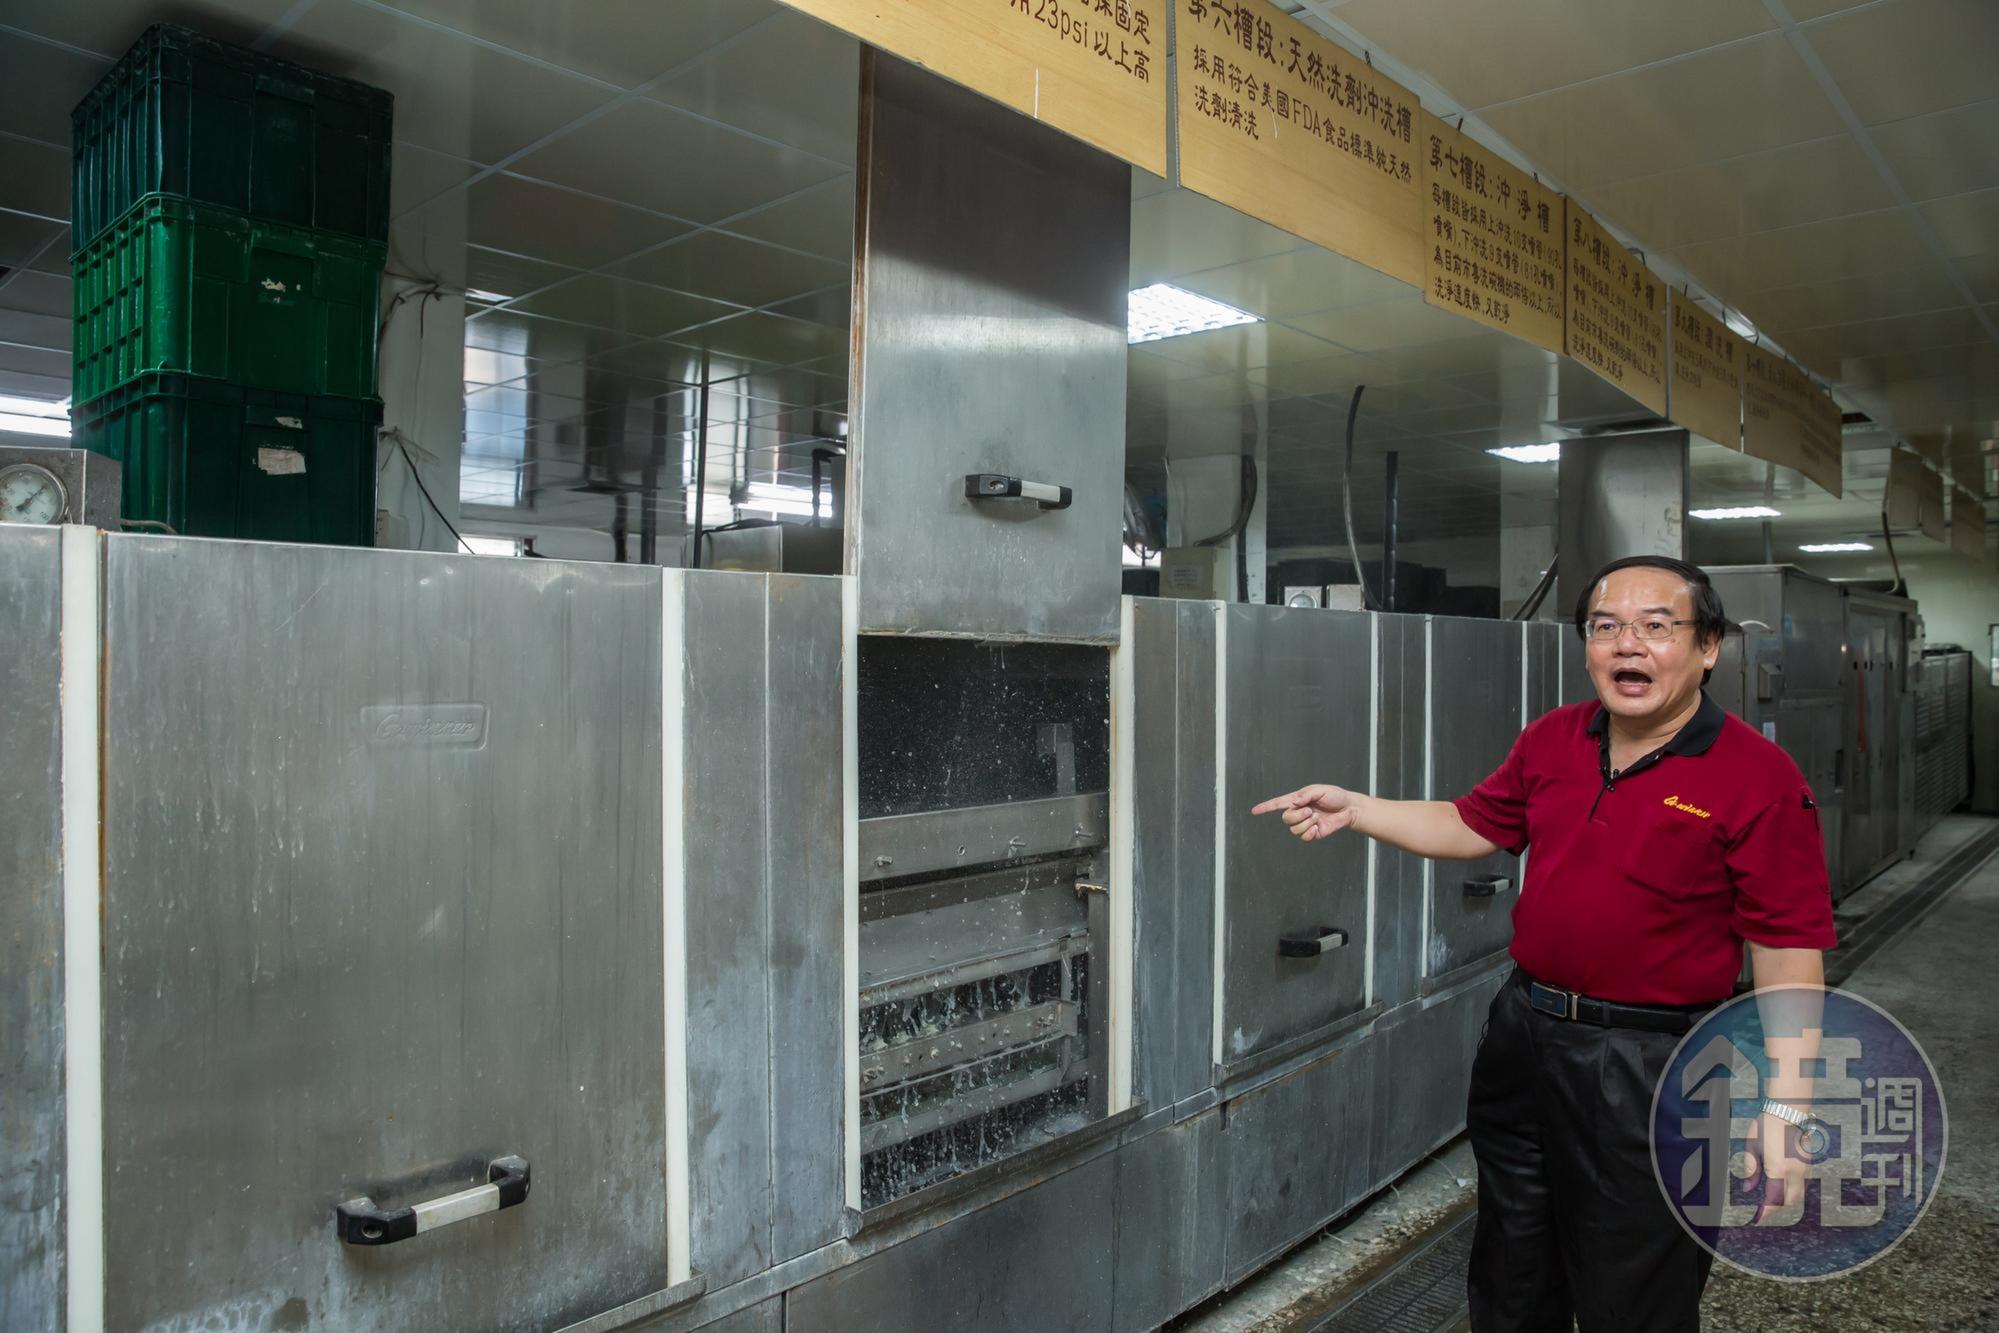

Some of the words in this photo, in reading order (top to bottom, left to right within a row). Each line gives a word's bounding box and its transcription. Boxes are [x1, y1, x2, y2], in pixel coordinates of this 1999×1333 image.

[1081, 0, 1150, 44] 固定
[1193, 44, 1412, 183] 採用符合美國FDA食品標準純天然
[1194, 84, 1259, 141] 洗劑清洗
